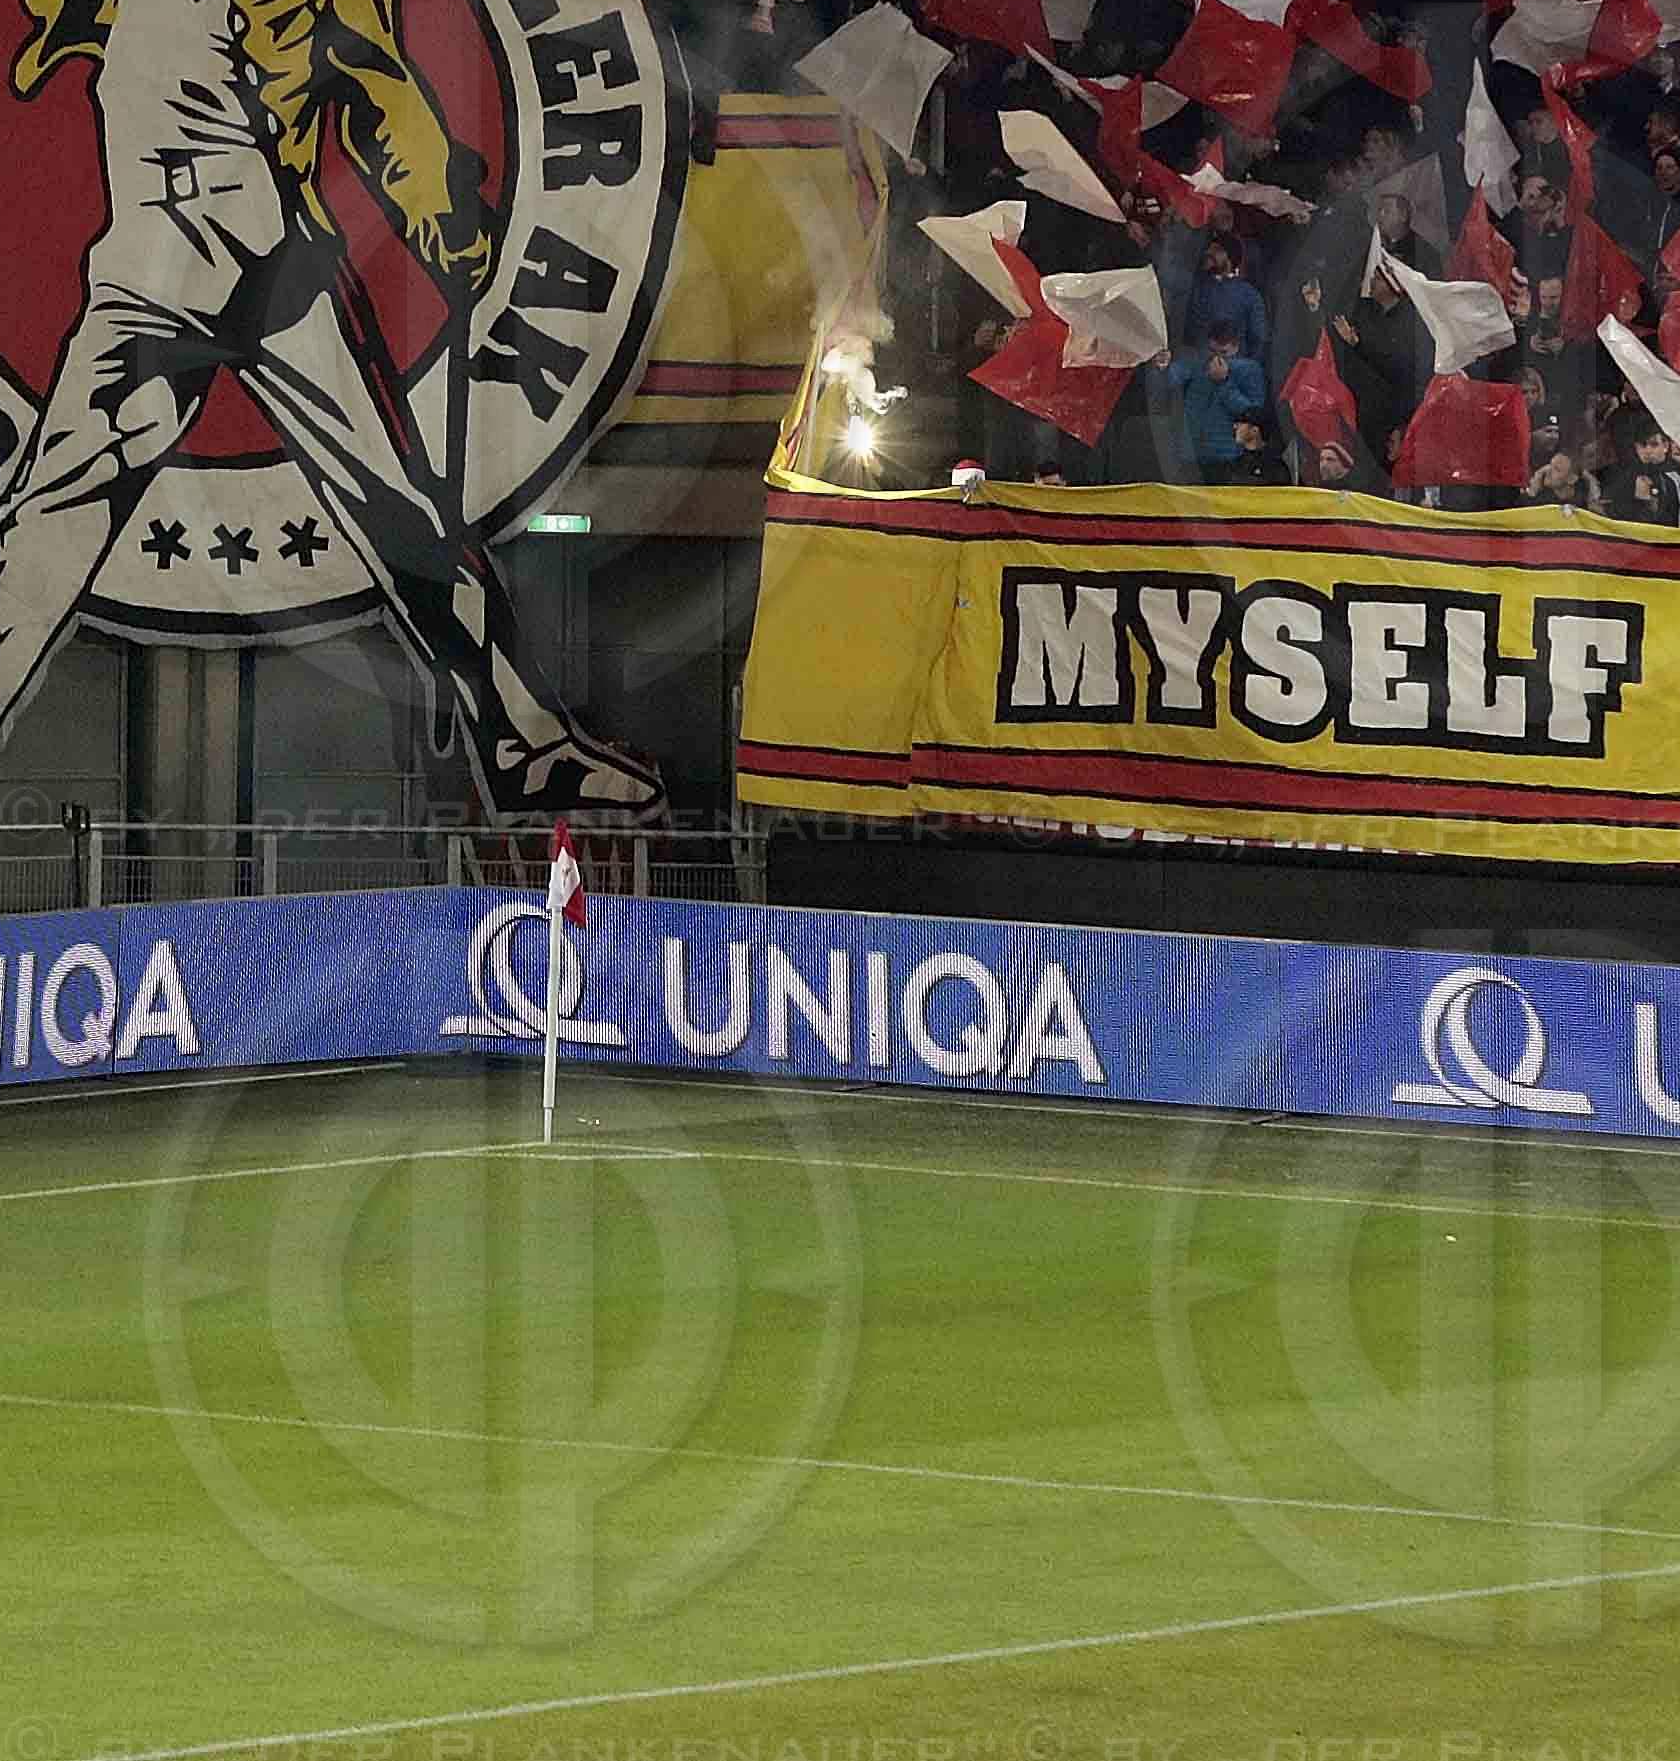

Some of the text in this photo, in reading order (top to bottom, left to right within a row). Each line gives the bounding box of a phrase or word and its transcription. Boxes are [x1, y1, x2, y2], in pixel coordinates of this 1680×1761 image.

[468, 225, 617, 423] AK
[998, 570, 1642, 755] MYSELF
[662, 934, 1107, 1085] UNIQA
